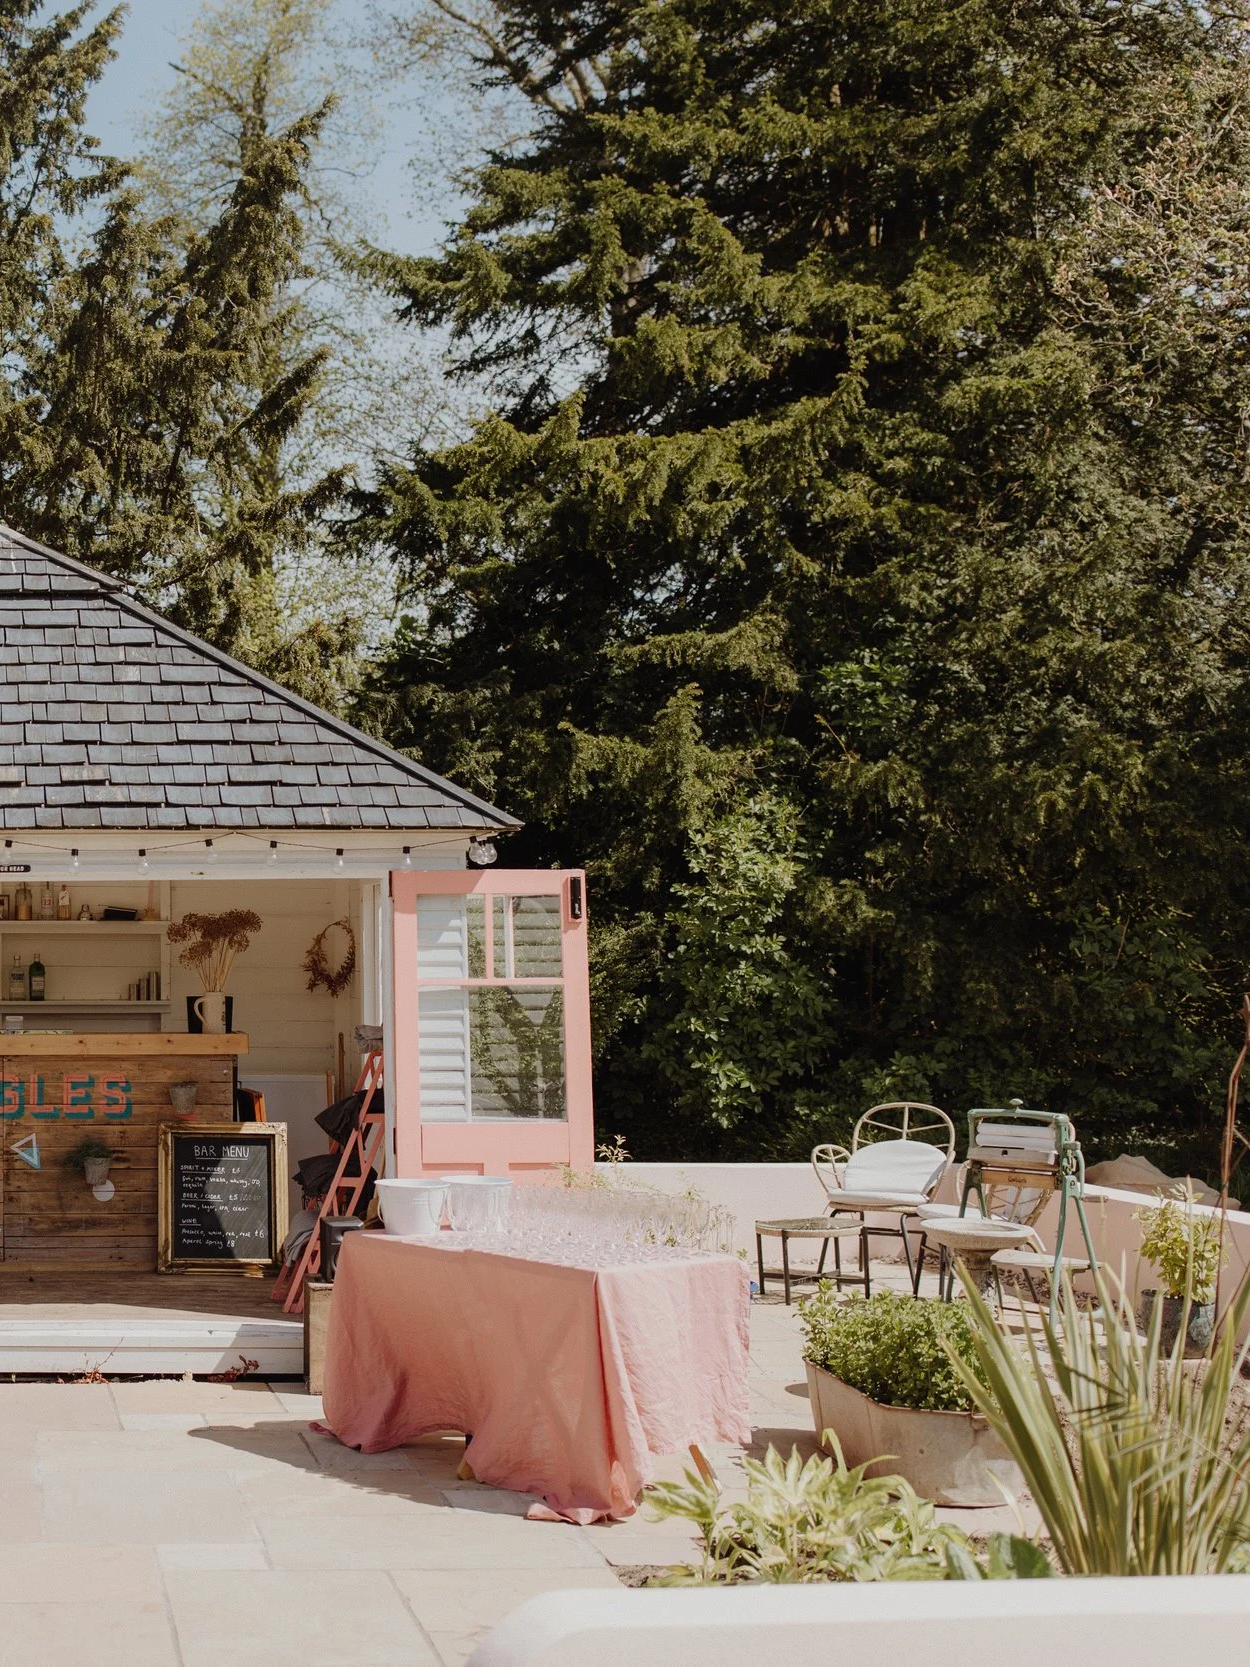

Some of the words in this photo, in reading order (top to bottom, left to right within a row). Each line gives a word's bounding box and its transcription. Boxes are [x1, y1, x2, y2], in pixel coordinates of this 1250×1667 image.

[194, 1145, 216, 1157] BAR
[222, 1145, 250, 1158] MENU
[254, 1229, 265, 1239] £6
[226, 1240, 237, 1248] £8
